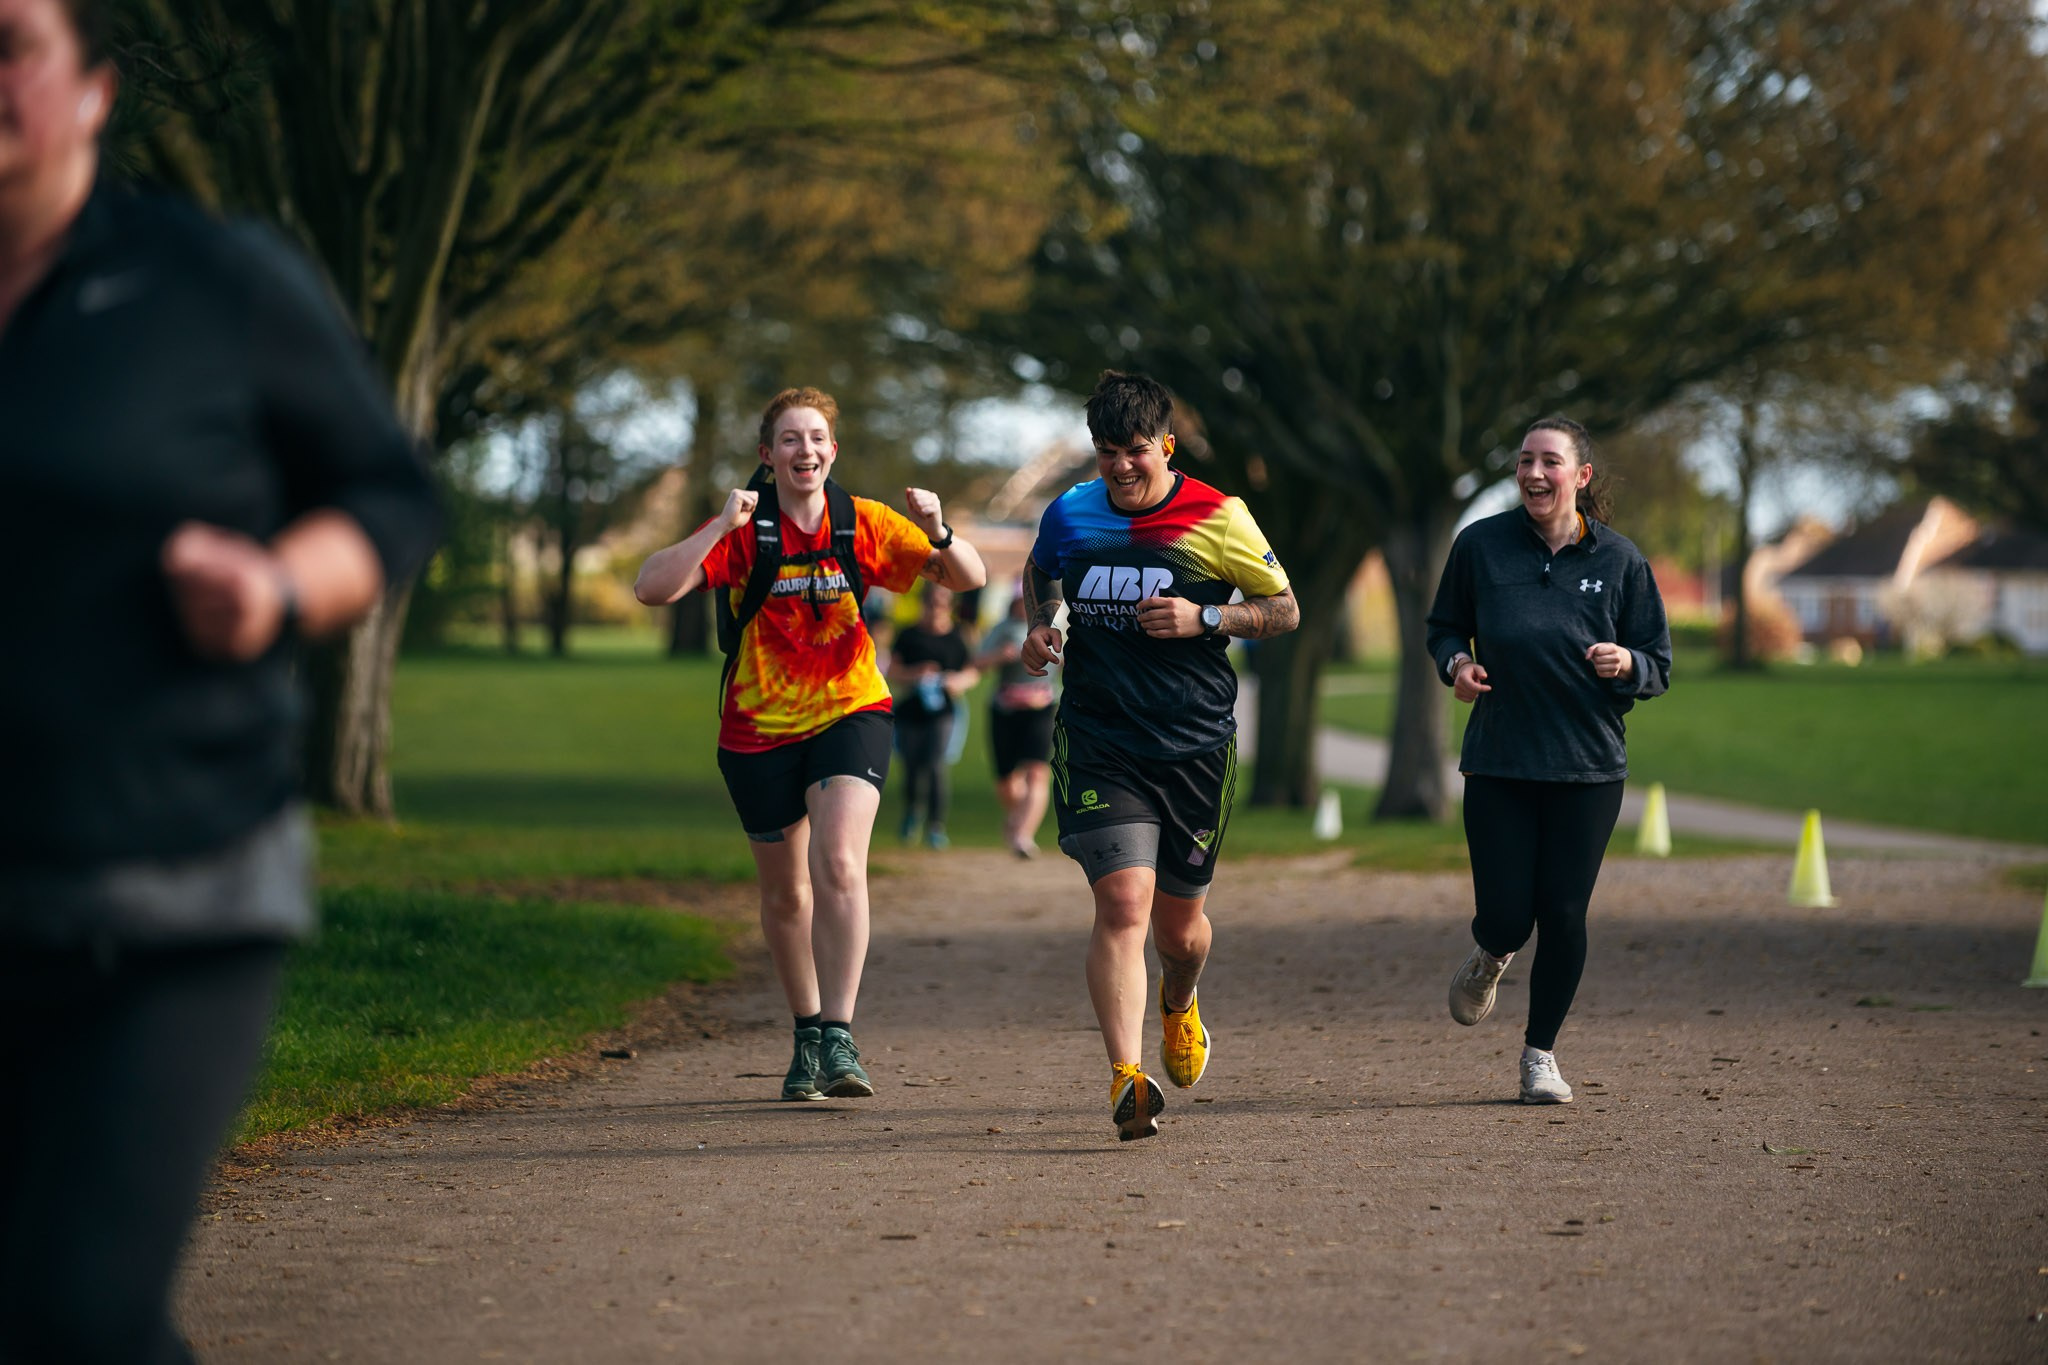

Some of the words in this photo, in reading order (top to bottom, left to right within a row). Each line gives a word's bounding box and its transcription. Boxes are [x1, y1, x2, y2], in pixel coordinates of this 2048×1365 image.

[770, 574, 849, 593] BOURNEMOUT
[1077, 565, 1173, 600] ABP
[1072, 602, 1143, 616] SOUTHAM
